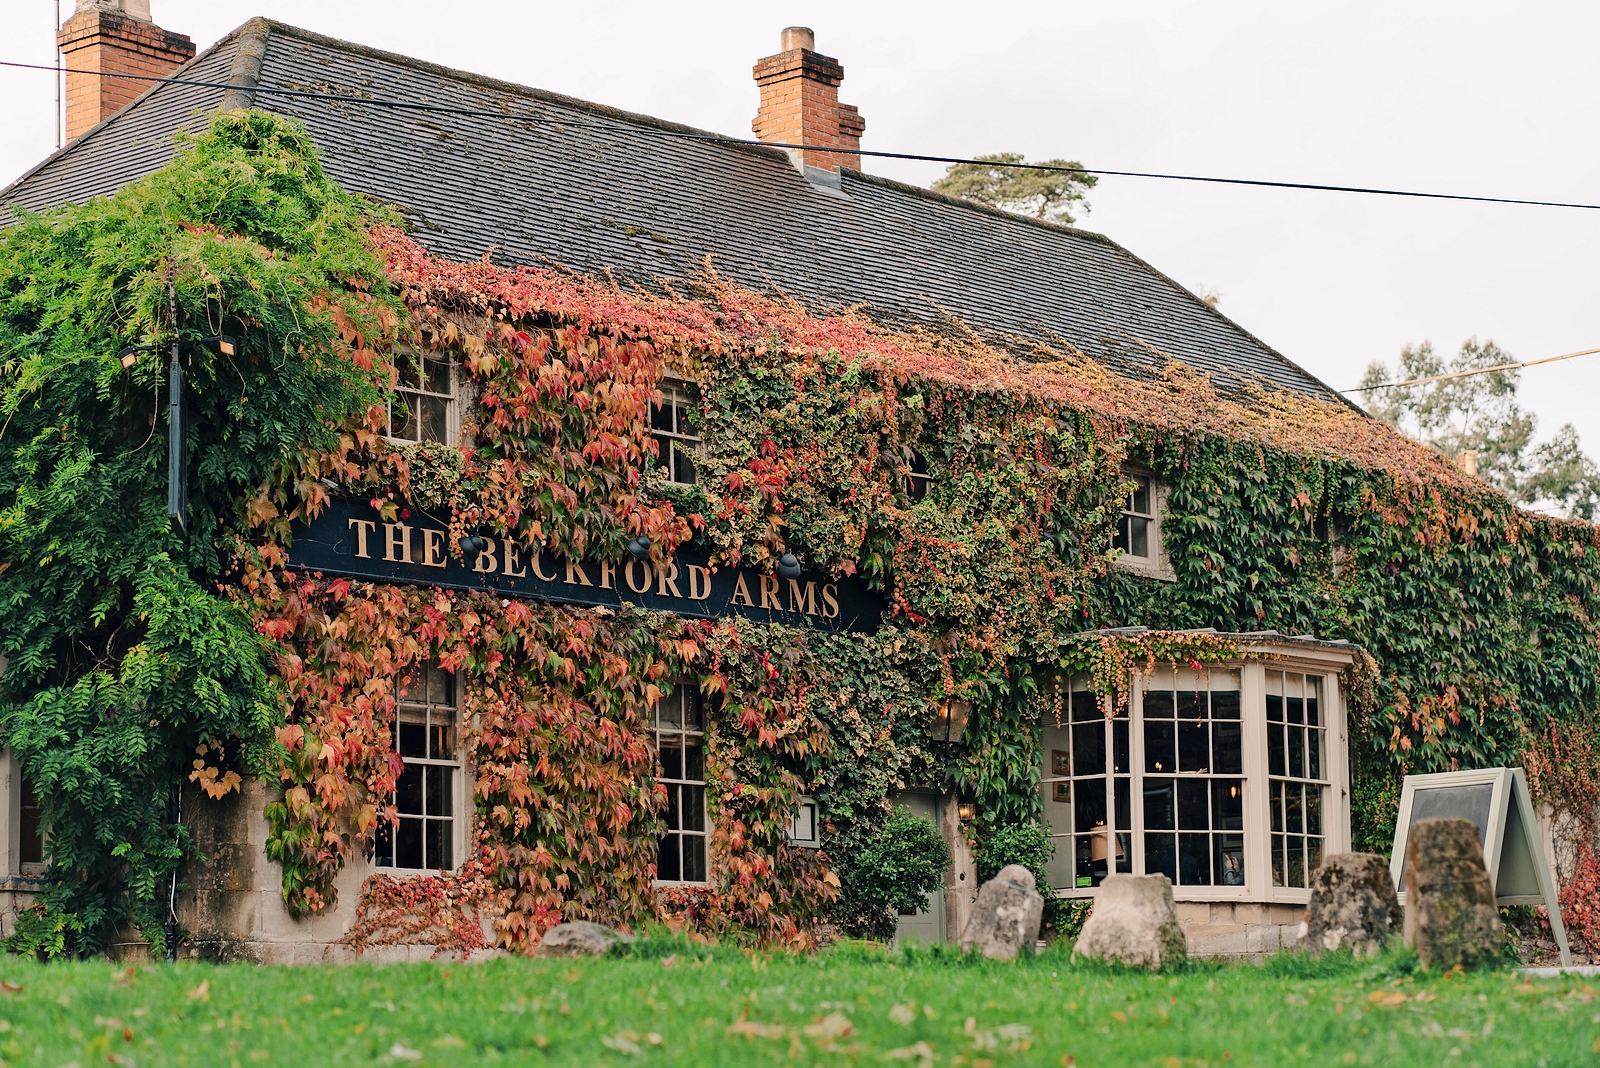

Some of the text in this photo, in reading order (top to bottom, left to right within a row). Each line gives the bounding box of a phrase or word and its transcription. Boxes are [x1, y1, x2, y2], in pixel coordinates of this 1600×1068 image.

[348, 518, 839, 619] THE BECKFORD ARMS
